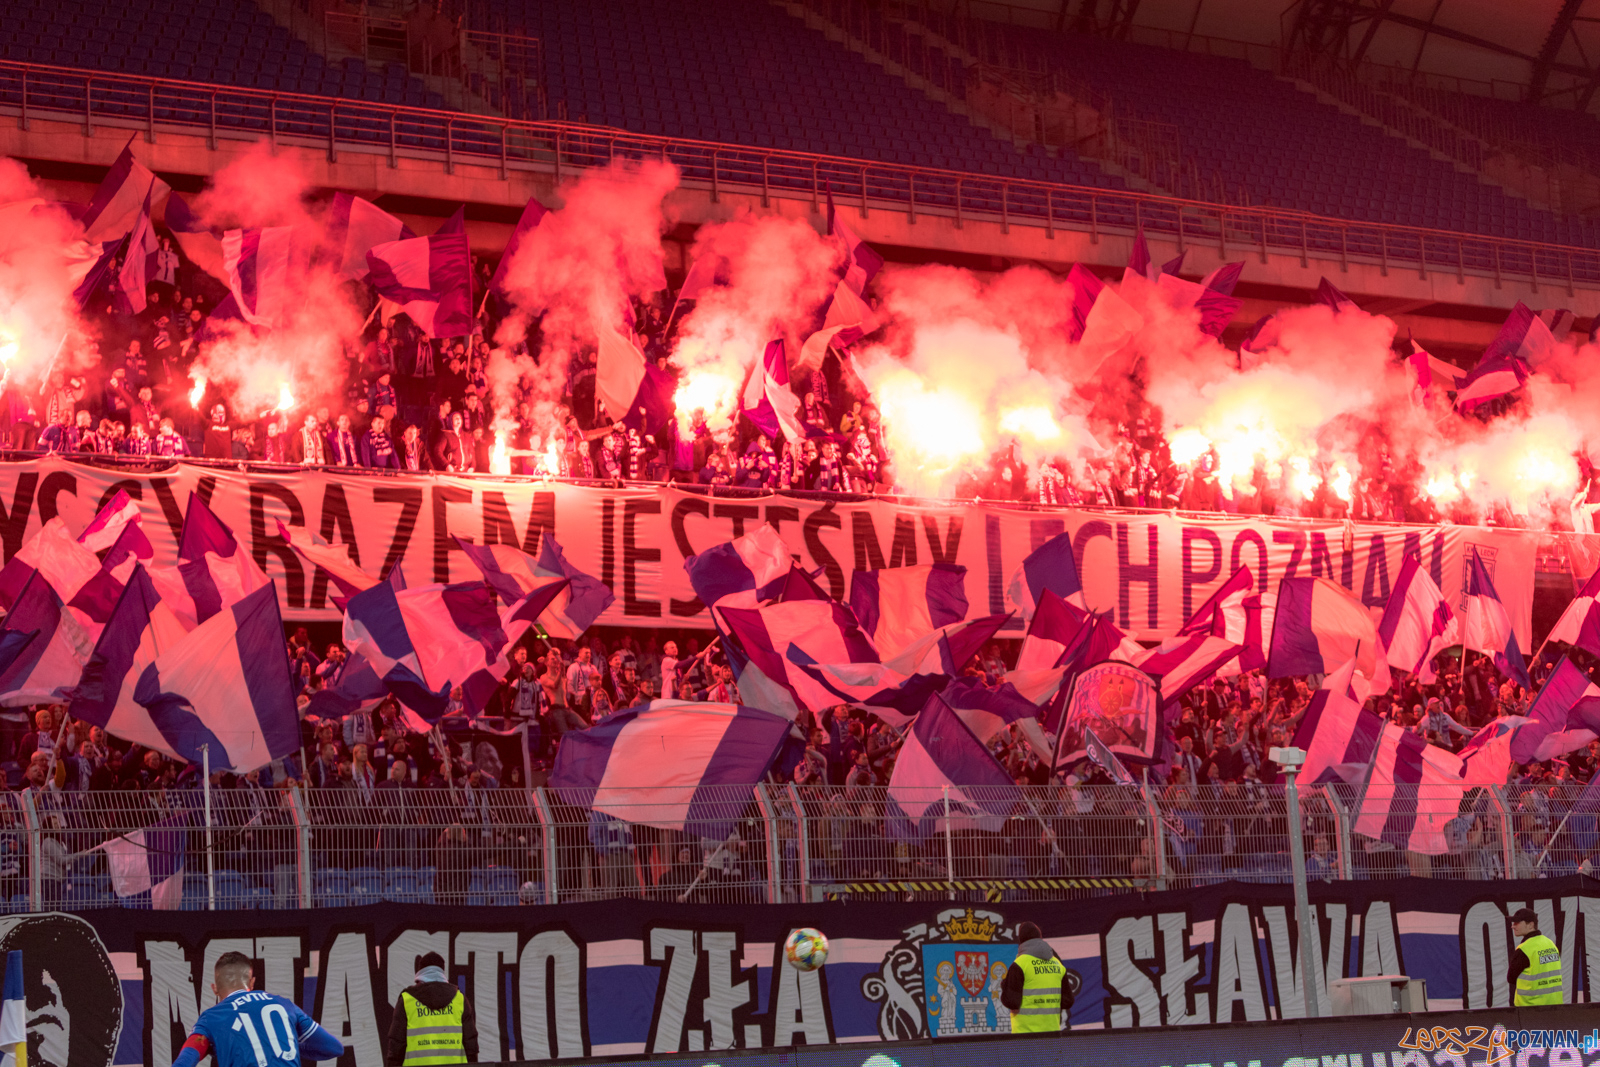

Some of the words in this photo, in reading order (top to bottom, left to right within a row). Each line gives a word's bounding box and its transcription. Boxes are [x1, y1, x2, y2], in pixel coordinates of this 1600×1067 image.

[249, 483, 555, 609] RAZEM
[231, 1003, 297, 1067] 10
[416, 1005, 454, 1018] BOKSER
